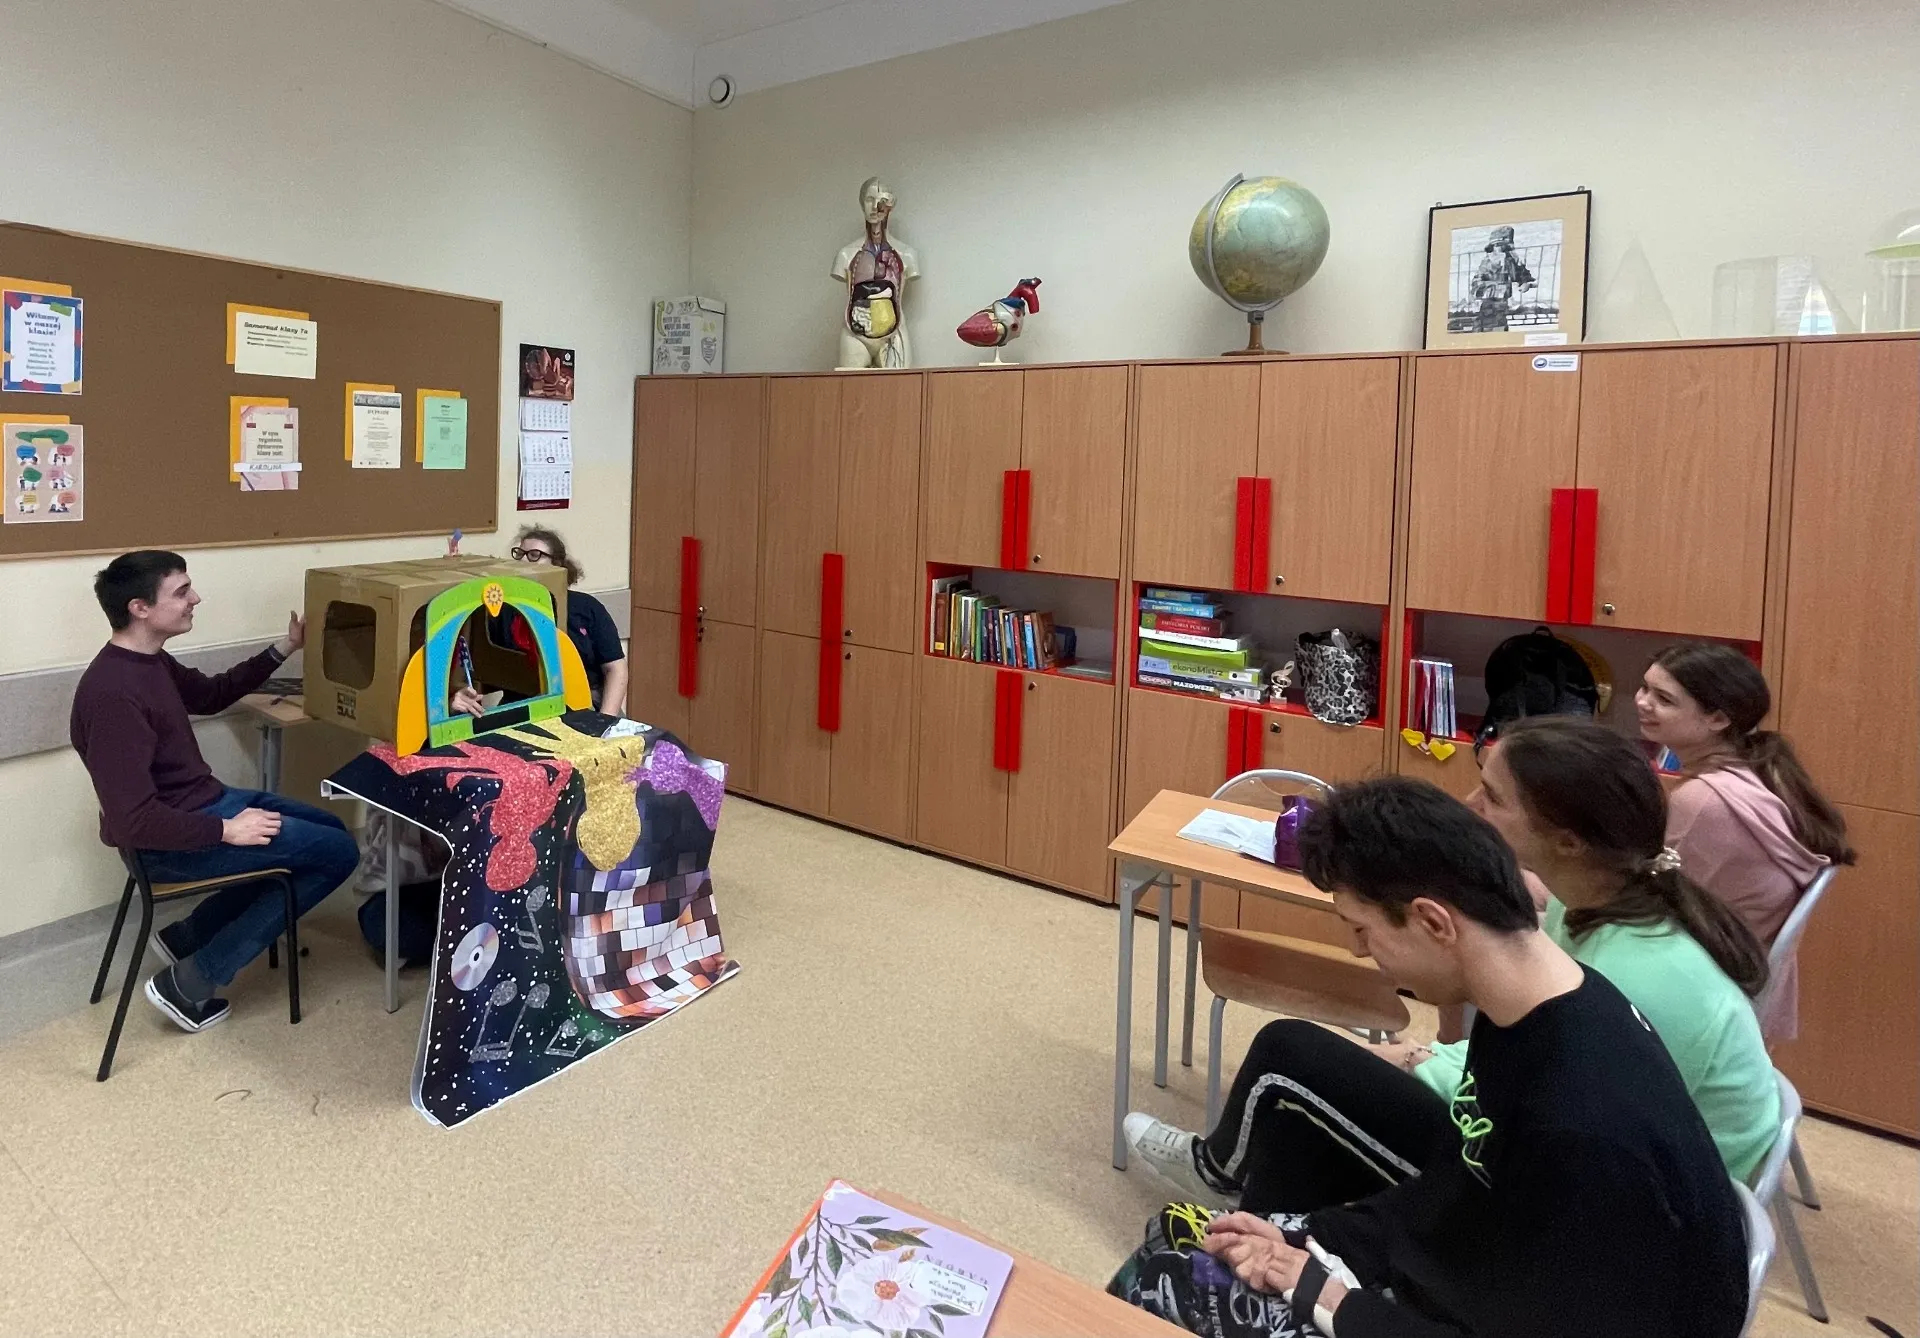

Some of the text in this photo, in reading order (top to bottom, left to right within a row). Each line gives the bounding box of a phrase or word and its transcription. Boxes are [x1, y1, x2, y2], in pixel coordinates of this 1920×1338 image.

[26, 312, 59, 322] Witamy
[34, 321, 61, 330] naszej
[280, 326, 299, 334] klasy
[28, 327, 57, 336] klasie!
[1161, 620, 1189, 630] HISTORIA
[1173, 664, 1224, 676] ekonoMistrz
[1139, 675, 1215, 692] MONOPOLY MAZOWSZE
